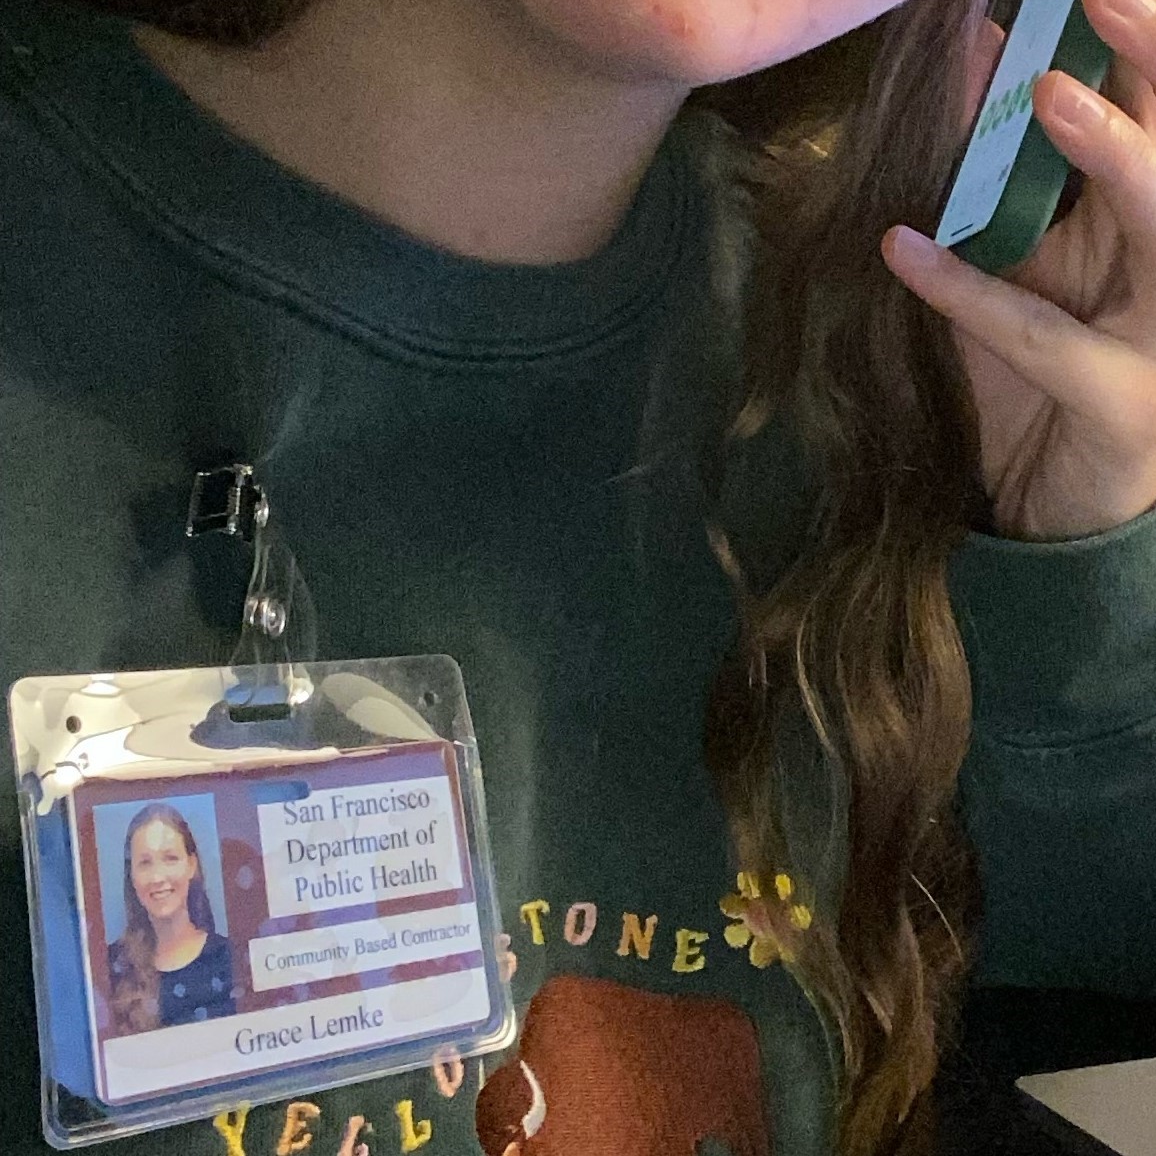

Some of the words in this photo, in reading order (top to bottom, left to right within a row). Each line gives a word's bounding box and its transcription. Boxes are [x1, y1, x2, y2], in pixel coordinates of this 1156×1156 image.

[283, 799, 326, 826] San
[331, 787, 431, 820] Francisco
[286, 828, 411, 868] Department
[416, 820, 438, 846] of
[295, 874, 364, 904] Public
[370, 858, 438, 891] Health
[264, 943, 350, 976] Community
[354, 933, 398, 959] Based
[401, 921, 472, 949] Contractor
[235, 1023, 303, 1057] Grace
[309, 1006, 384, 1041] Lemke
